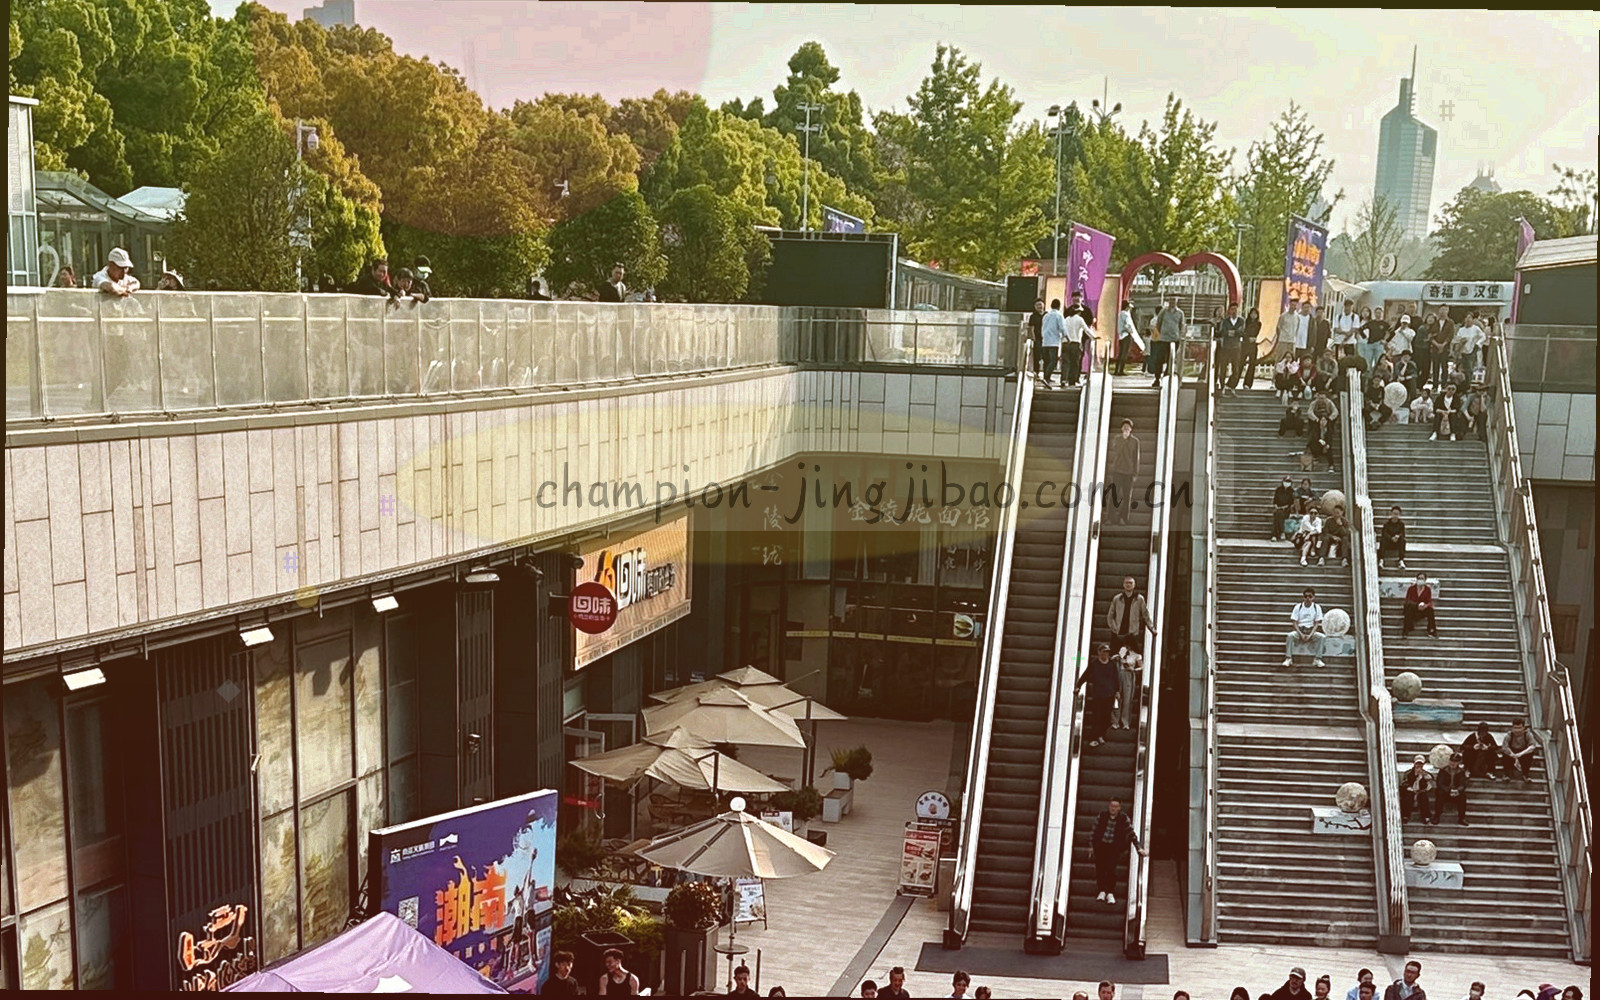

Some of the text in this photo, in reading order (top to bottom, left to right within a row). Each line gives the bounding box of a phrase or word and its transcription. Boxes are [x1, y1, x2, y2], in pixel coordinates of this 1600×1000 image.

[1430, 285, 1499, 298] 奇福 汉堡
[572, 595, 611, 615] 回味
[434, 855, 507, 948] 潮南
